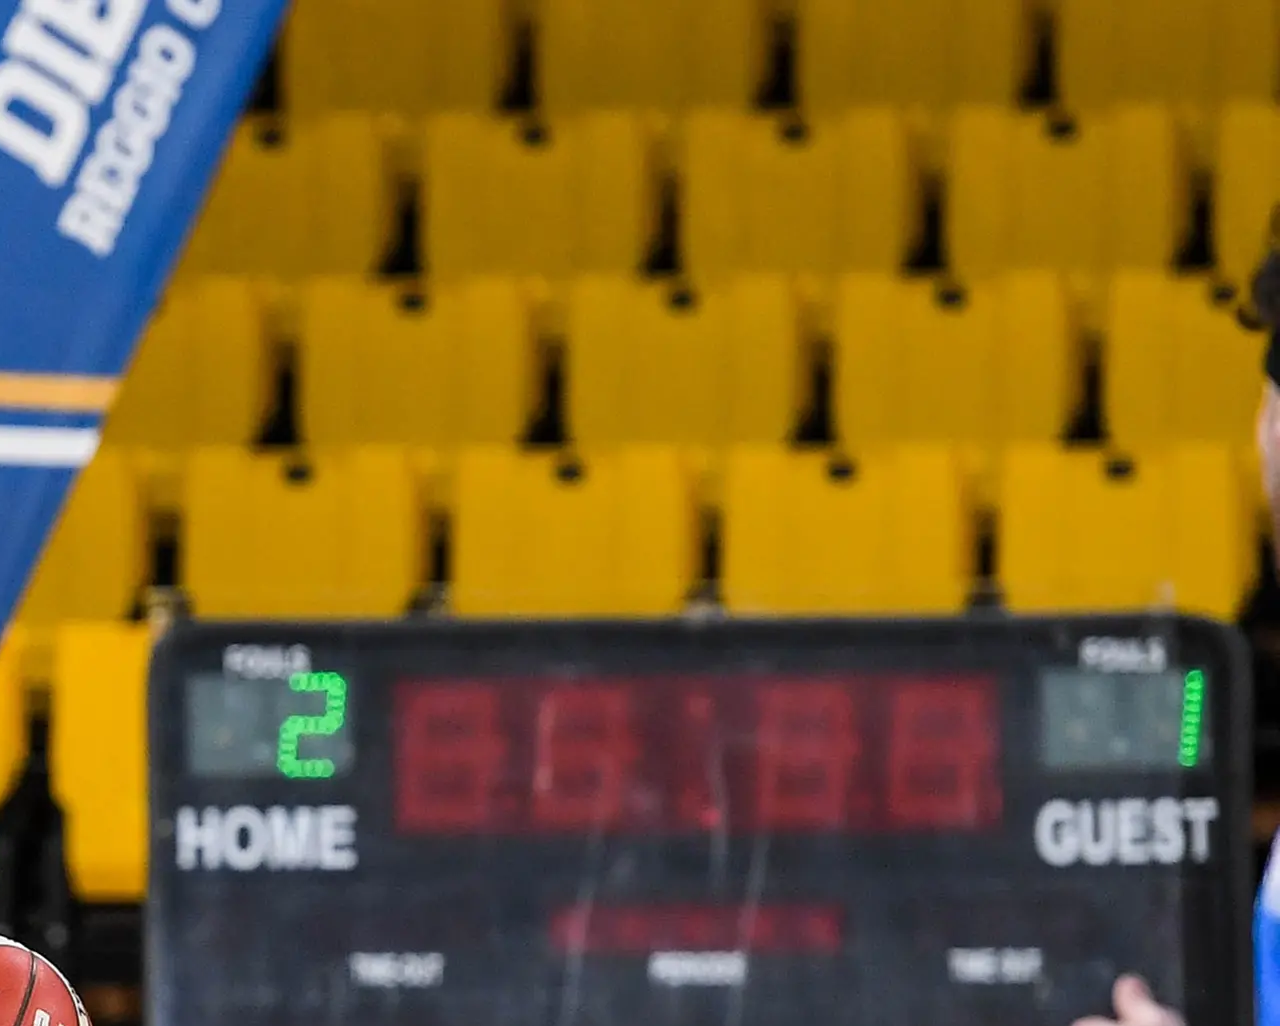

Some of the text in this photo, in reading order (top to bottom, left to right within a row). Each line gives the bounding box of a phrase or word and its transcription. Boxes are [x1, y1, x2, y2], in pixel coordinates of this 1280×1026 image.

[276, 671, 347, 779] 2
[1177, 669, 1204, 767] 1
[176, 805, 358, 870] HOME
[1035, 797, 1219, 866] GUEST
